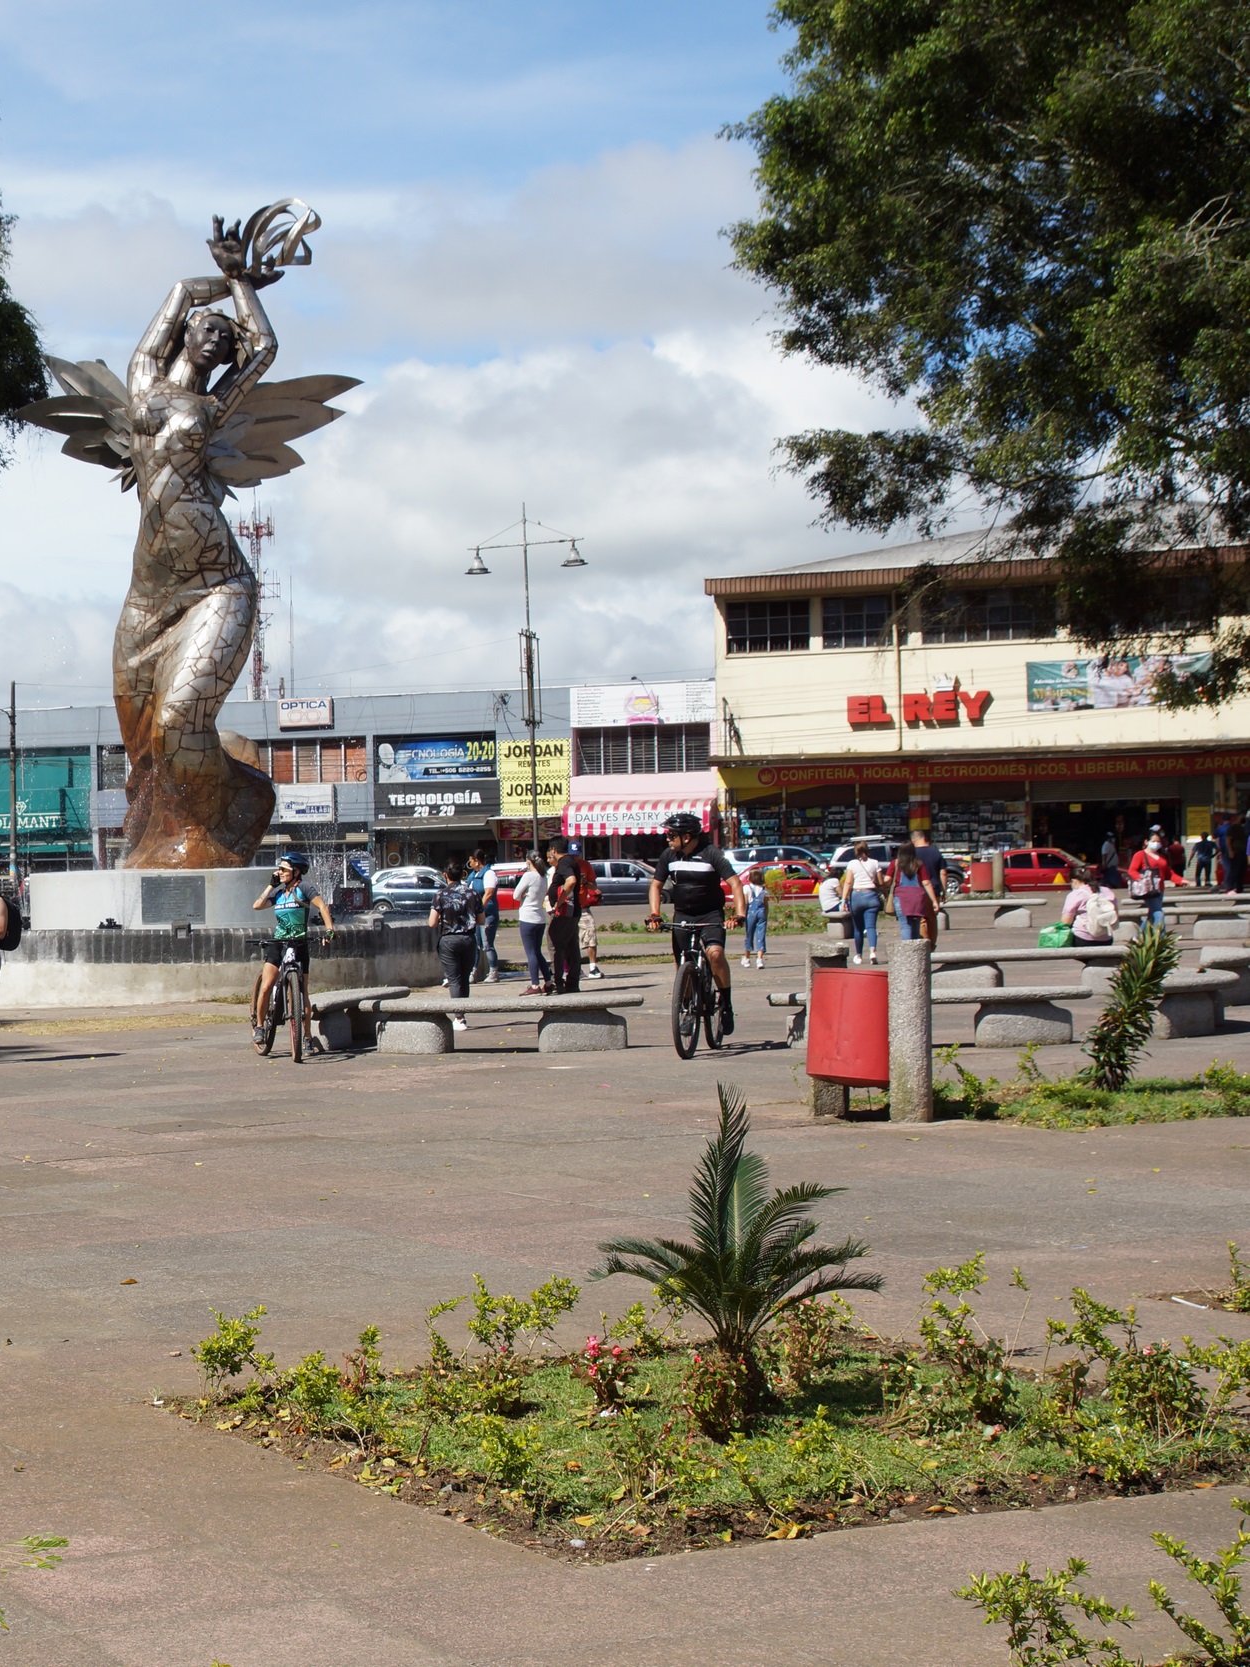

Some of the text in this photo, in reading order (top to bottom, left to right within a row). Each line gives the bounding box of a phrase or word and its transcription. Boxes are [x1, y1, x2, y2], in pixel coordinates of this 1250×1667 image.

[281, 700, 327, 710] OPTICA
[847, 690, 991, 724] EL REY
[466, 741, 495, 761] 20-20
[504, 743, 563, 758] JORDAN
[780, 765, 860, 781] CONFITERÍA,
[863, 767, 914, 780] HOGAR,
[917, 761, 1070, 778] ELECTRODOMÉSTICOS,
[1075, 758, 1143, 774] LIBRERÍA,
[1147, 758, 1189, 772] ROPA,
[506, 782, 562, 797] JORDAN
[388, 790, 482, 806] TECNOLOGÍA
[413, 806, 430, 818] 20
[439, 805, 455, 817] 20
[575, 813, 619, 822] DALIYES
[622, 812, 660, 821] PASTRY
